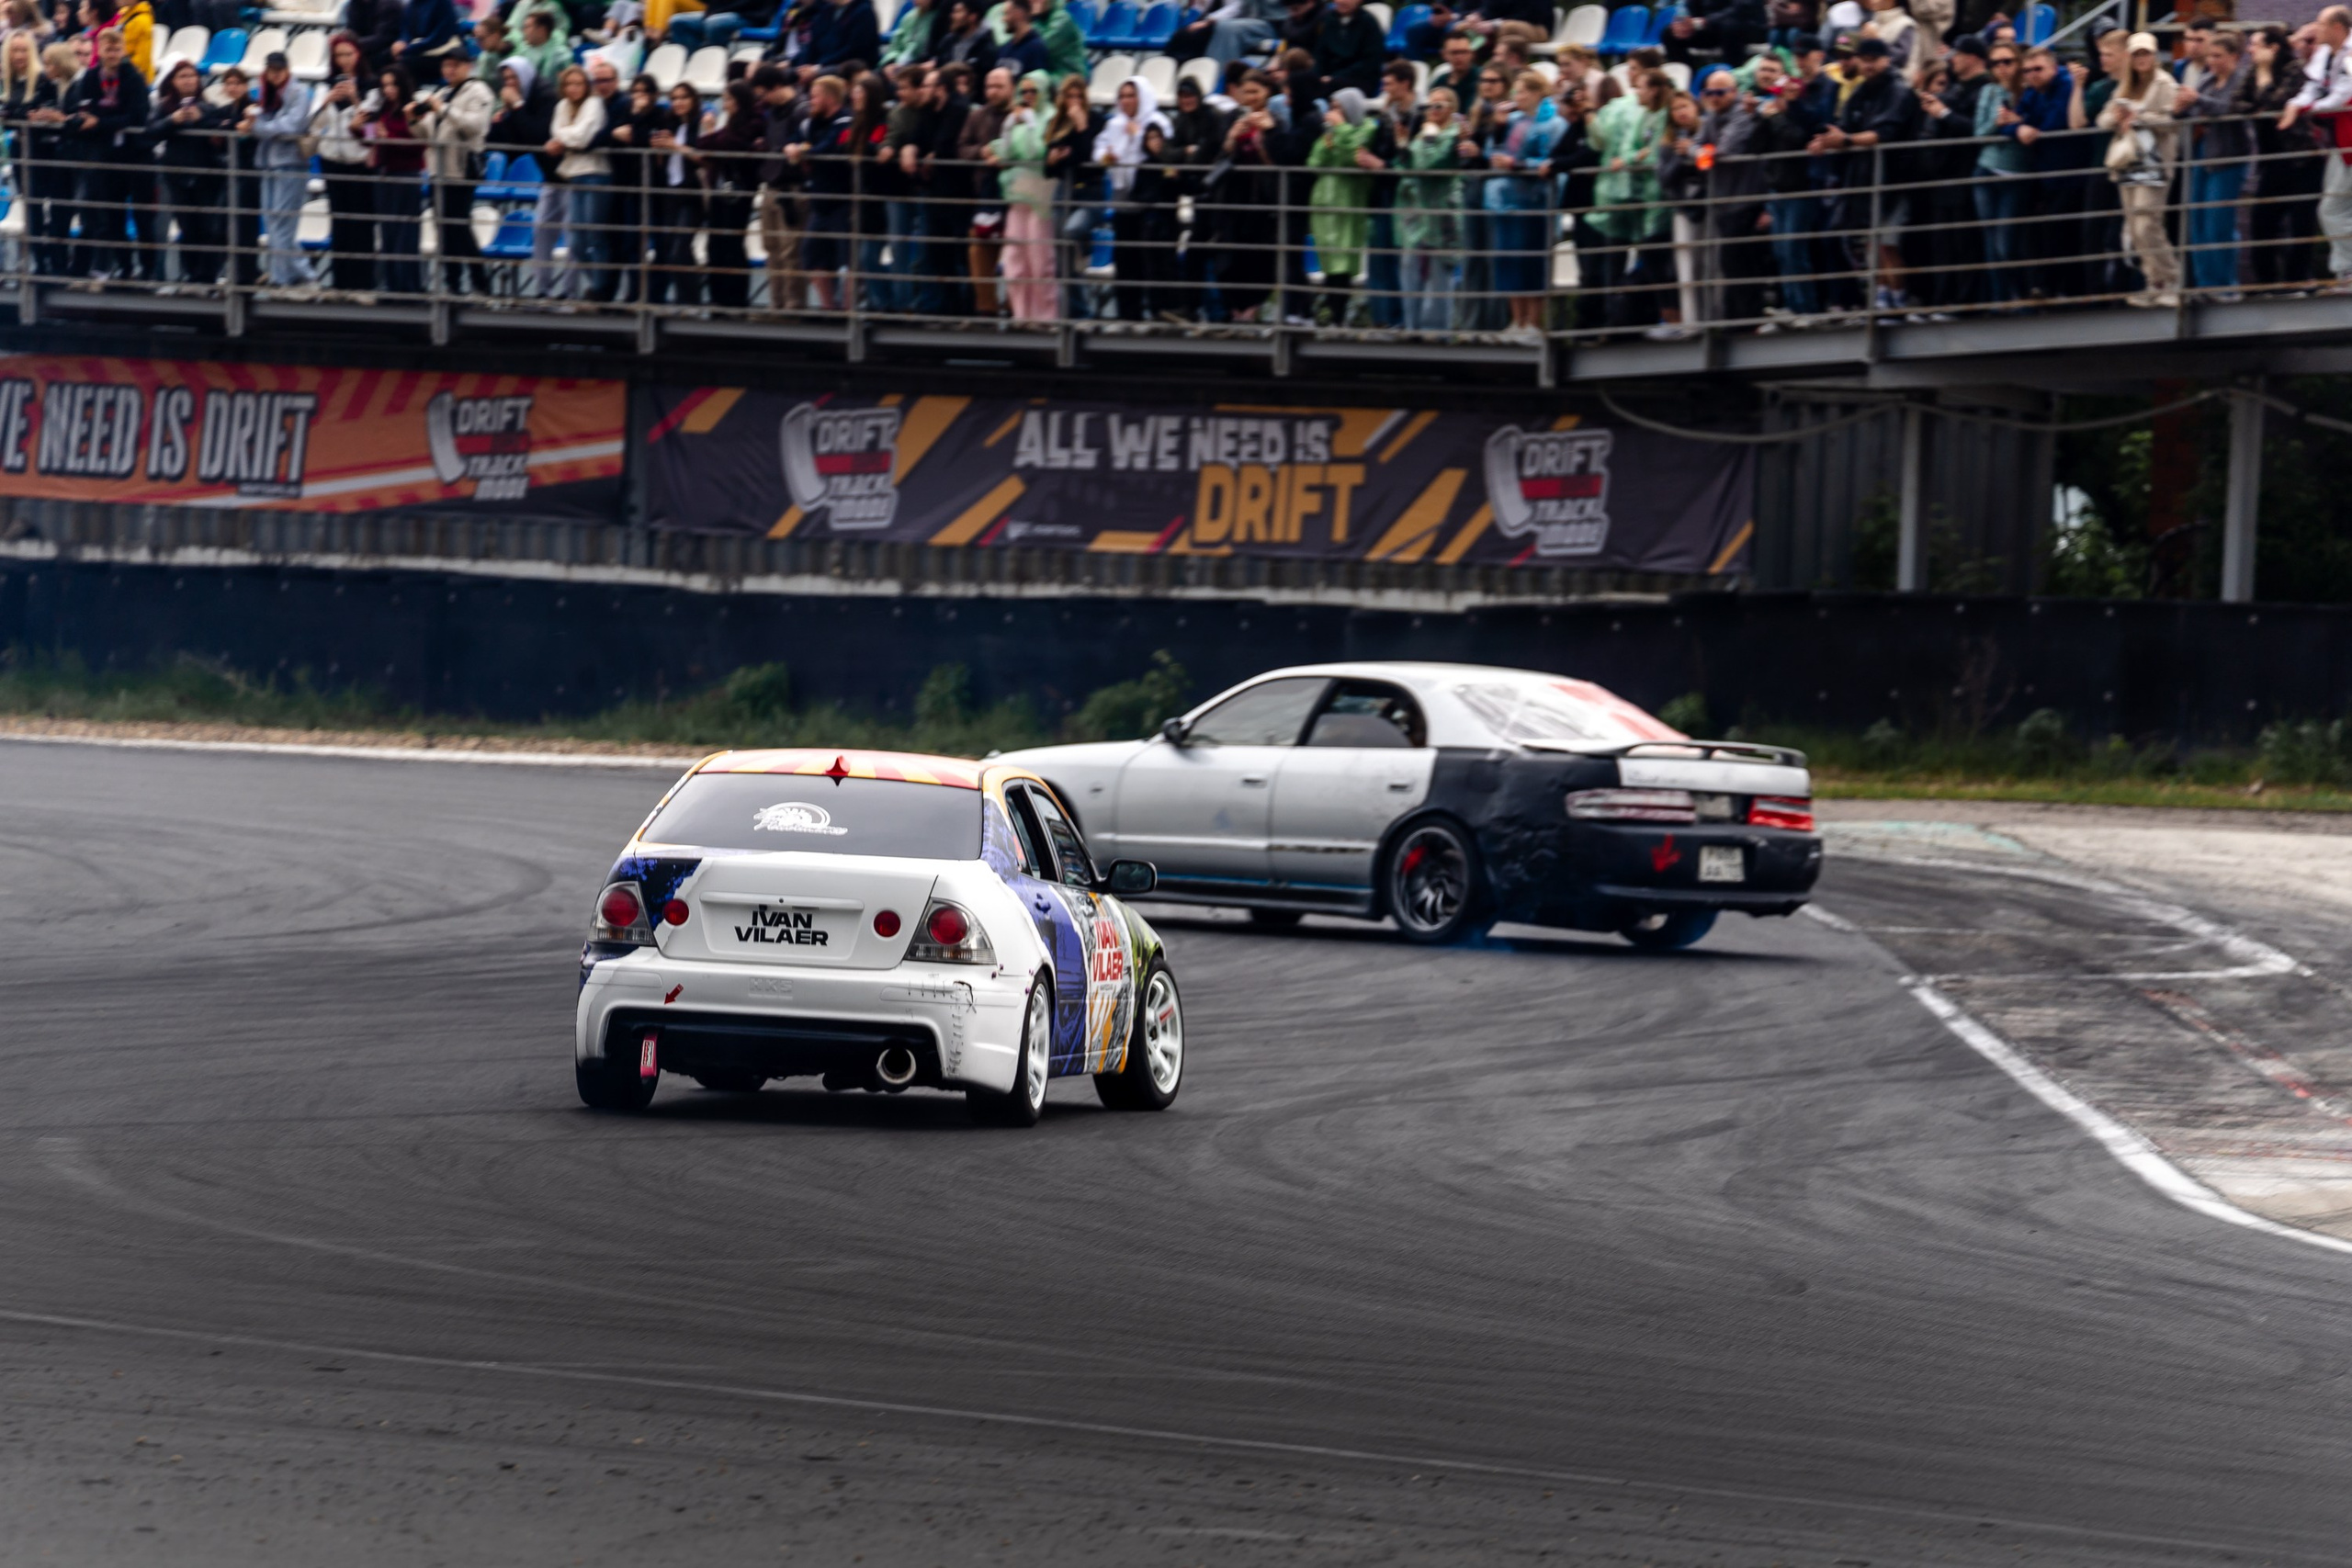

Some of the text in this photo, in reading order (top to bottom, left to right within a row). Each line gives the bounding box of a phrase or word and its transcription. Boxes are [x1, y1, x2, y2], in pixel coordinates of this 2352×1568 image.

[39, 383, 141, 475] NEED
[147, 387, 193, 478] IS
[198, 390, 316, 481] DRIFT
[457, 398, 532, 433] DRIFT
[816, 419, 895, 453] DRIFT
[1013, 410, 1330, 471] ALL WE NEED IS
[1521, 440, 1606, 477] DRIFT
[1193, 463, 1366, 543] DRIFT
[734, 925, 829, 947] VILAER
[752, 909, 813, 930] IVAN
[1093, 919, 1118, 950] IVAN
[1091, 950, 1124, 983] VILAER
[749, 976, 794, 995] HKS
